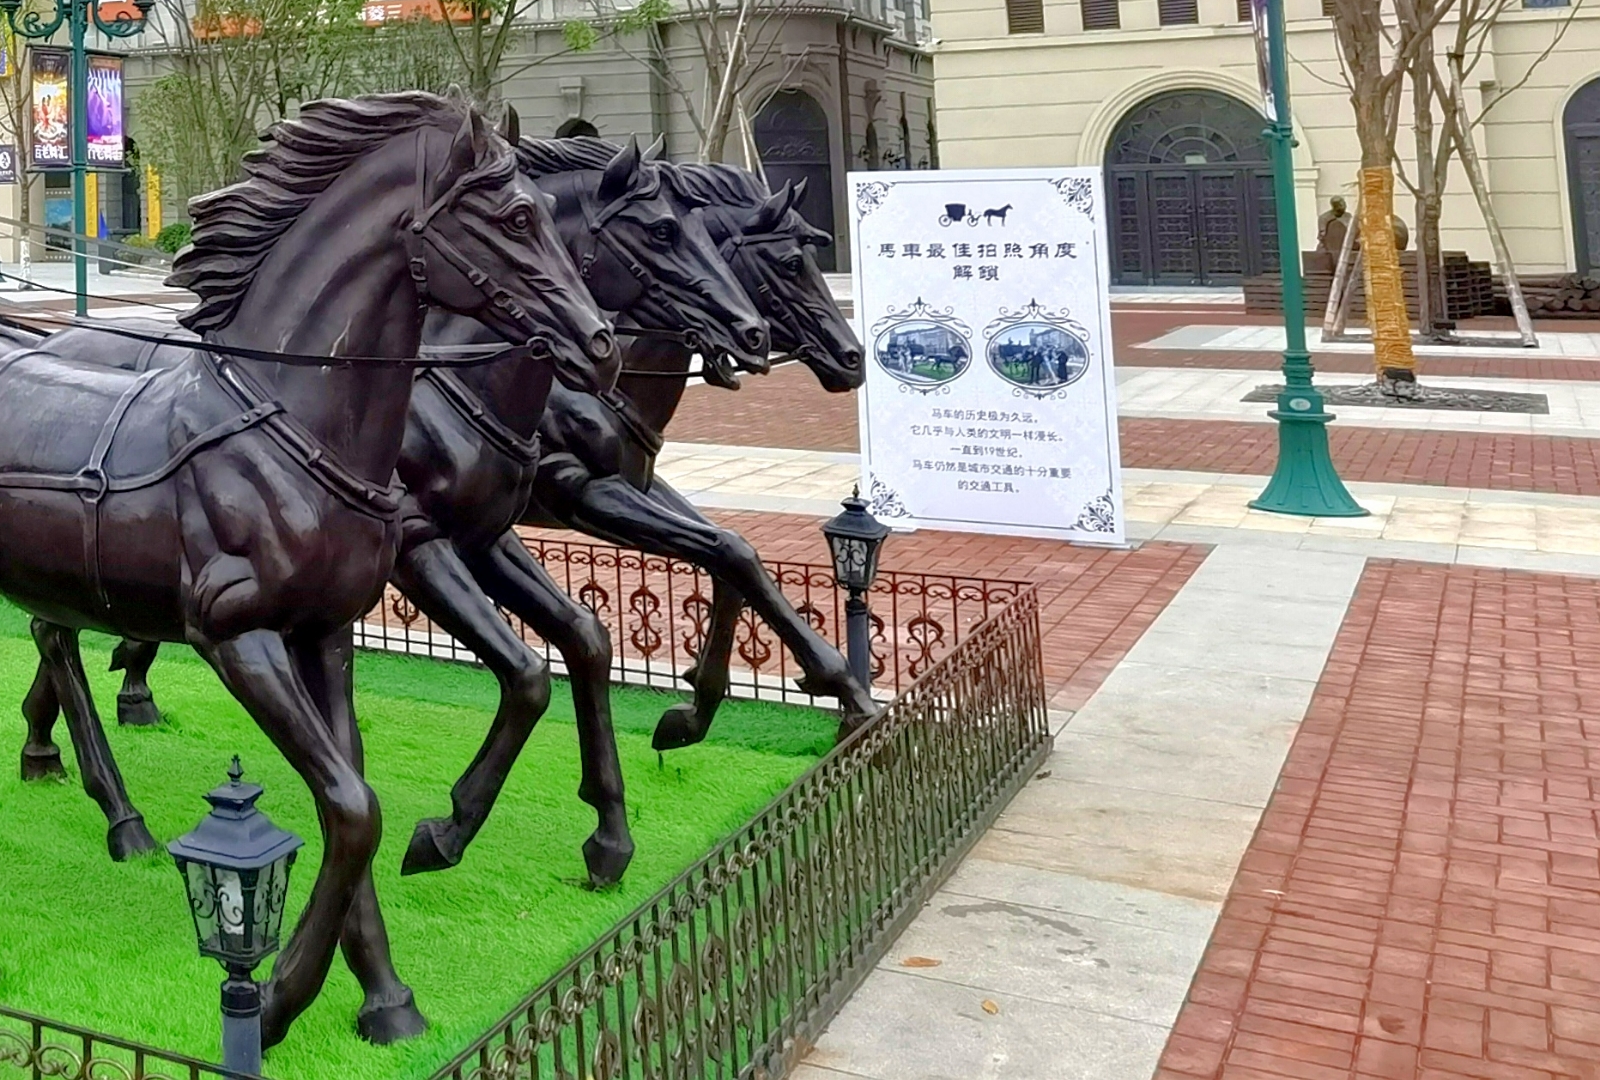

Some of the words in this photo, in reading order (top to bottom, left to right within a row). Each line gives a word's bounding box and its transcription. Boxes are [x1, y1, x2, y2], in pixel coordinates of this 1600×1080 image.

[877, 242, 1078, 259] 馬車最佳拍照角度
[952, 265, 1000, 281] 解鎖
[912, 459, 1072, 479] 马车仍然是城市交通的十分重要
